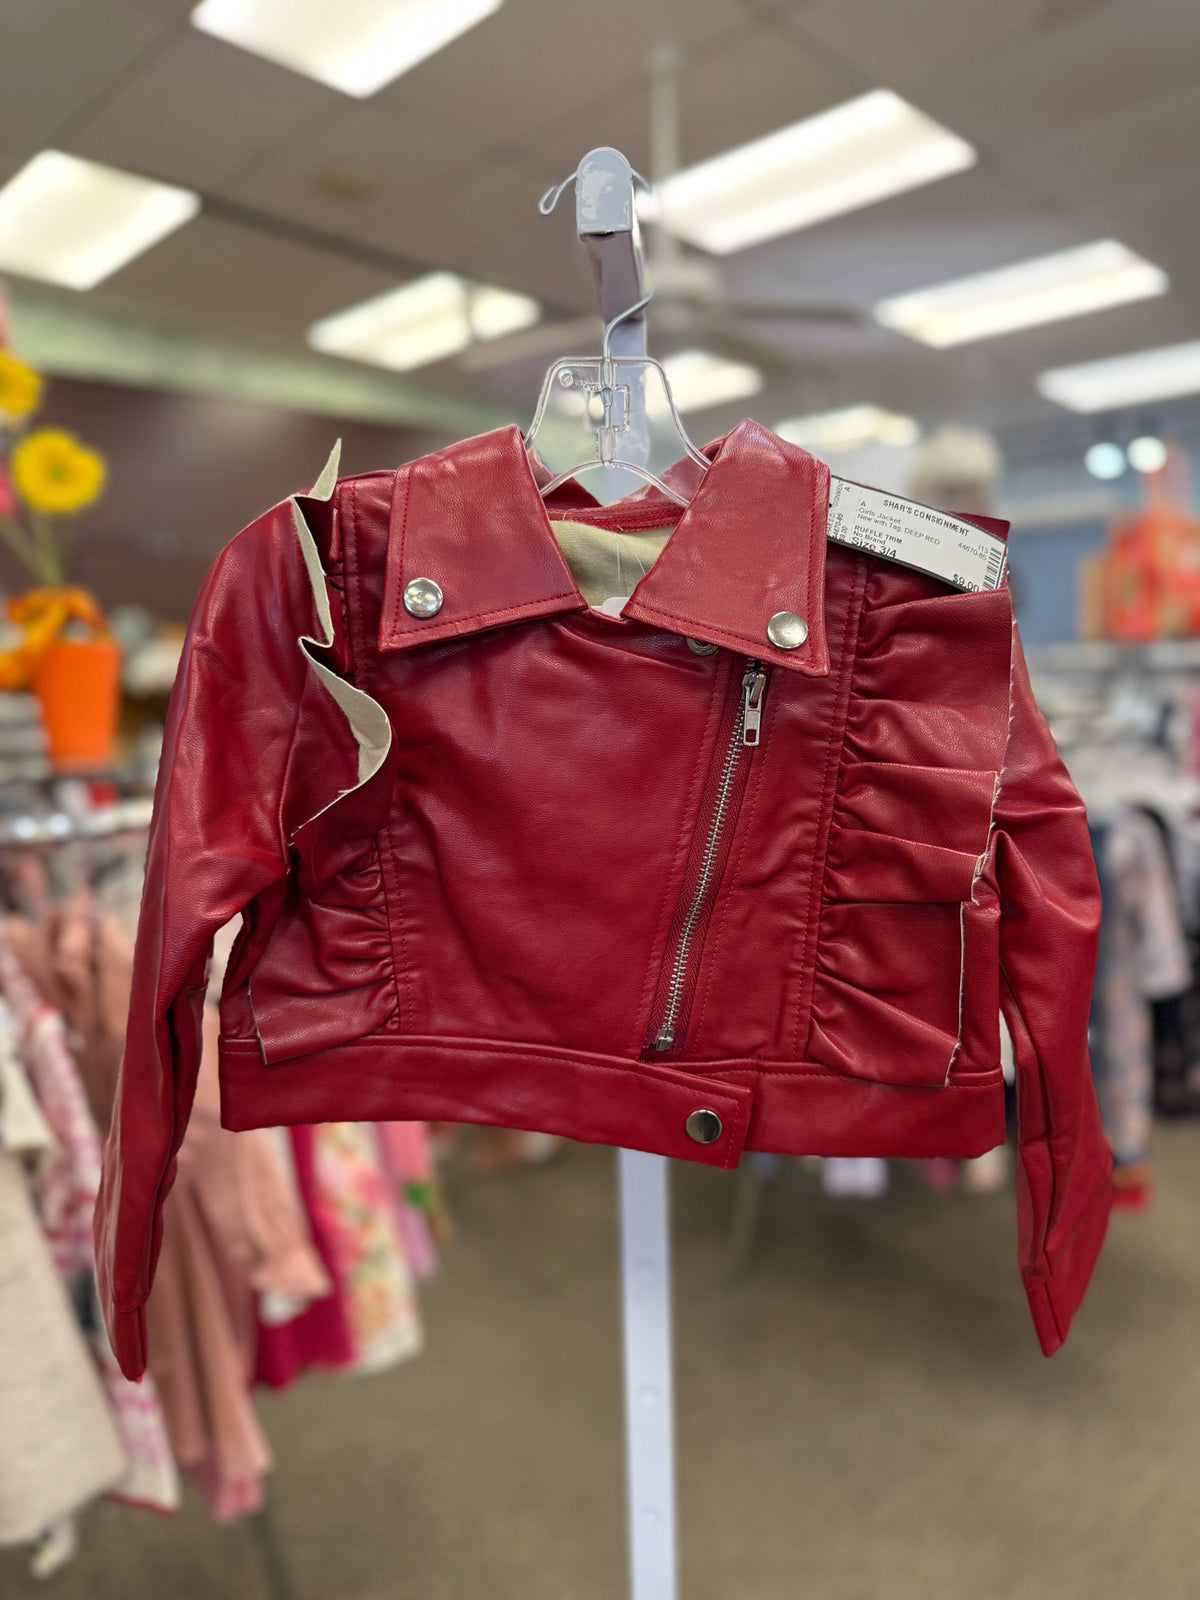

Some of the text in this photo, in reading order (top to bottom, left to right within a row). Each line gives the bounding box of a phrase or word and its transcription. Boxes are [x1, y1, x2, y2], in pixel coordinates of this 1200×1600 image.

[859, 507, 901, 524] Girls Jacket
[883, 500, 969, 536] SHAR'S CONSIGNMENT
[854, 525, 903, 544] RUFFLE TRIM
[857, 513, 872, 522] New
[874, 519, 887, 527] with
[904, 527, 924, 538] DEEP
[925, 535, 941, 545] RED
[851, 536, 897, 558] Size 3/4
[865, 533, 886, 545] Brand
[958, 542, 987, 561] 44670-85
[953, 573, 979, 592] $9.00
